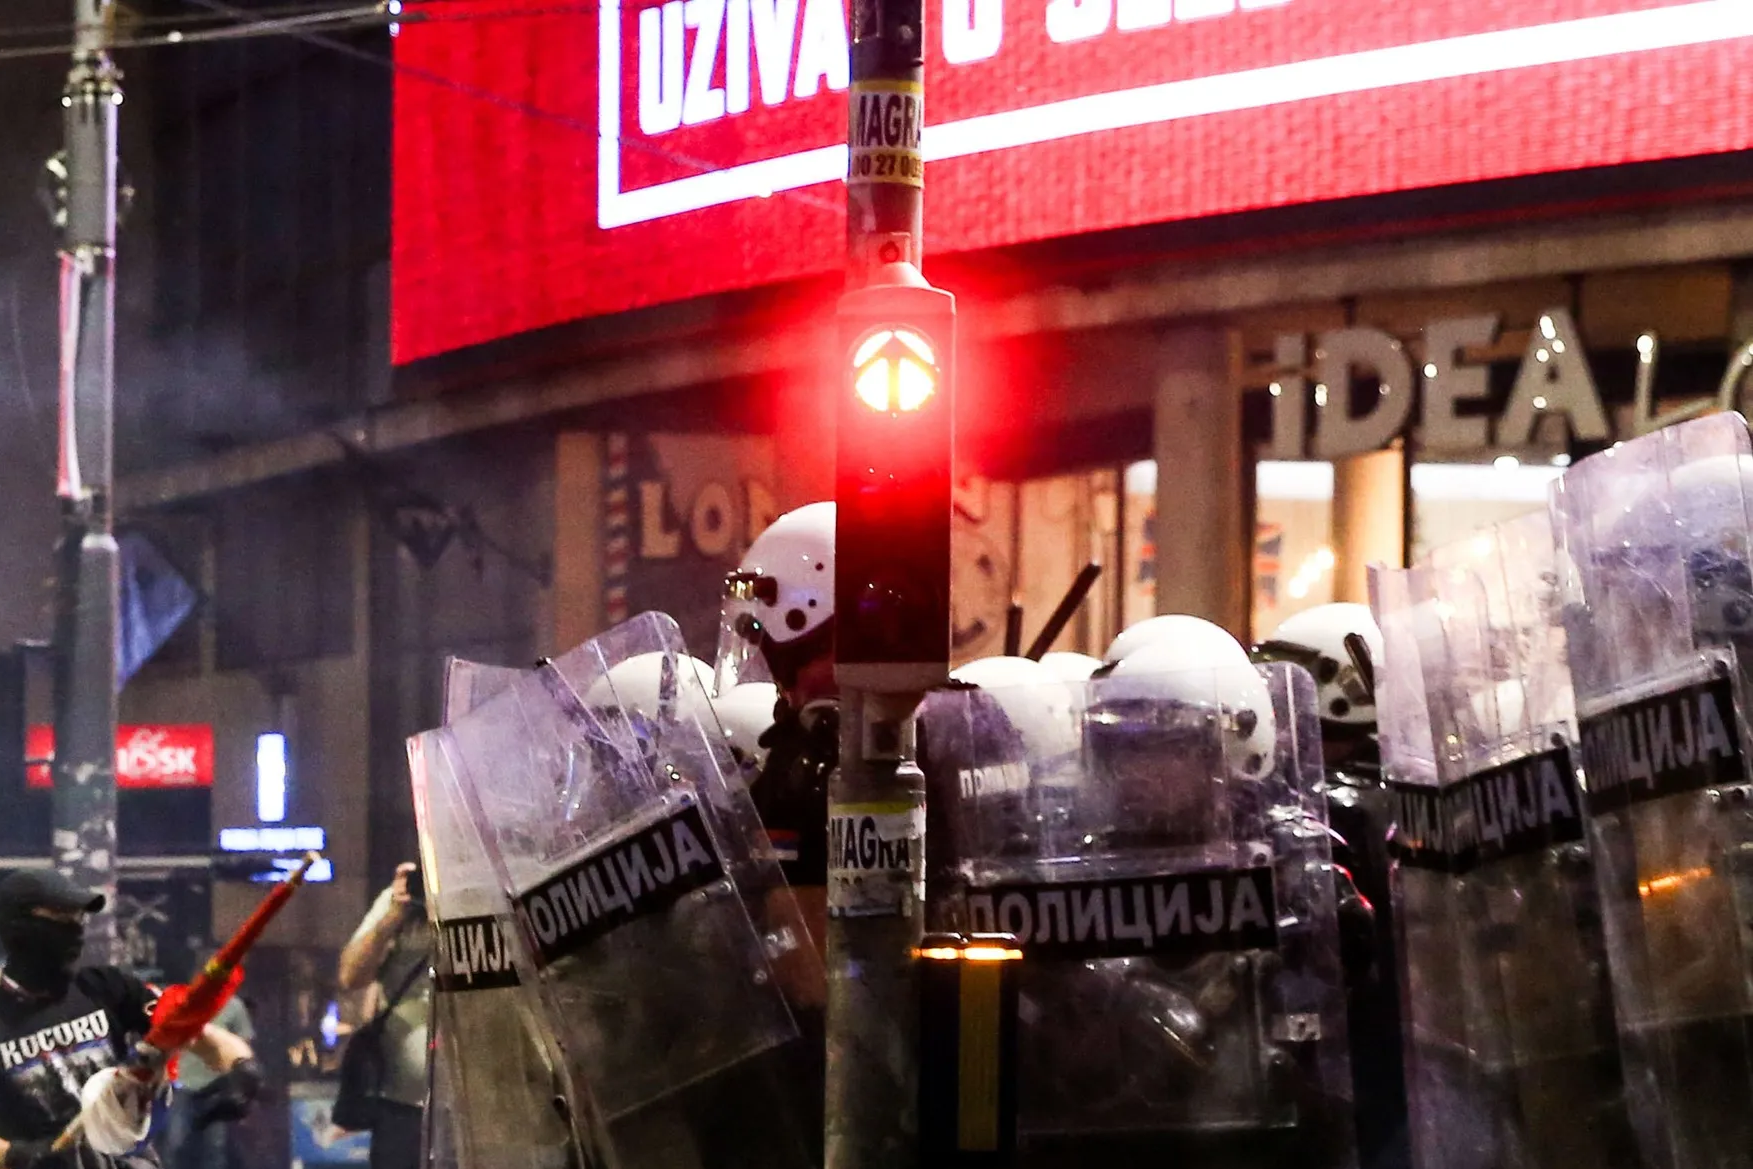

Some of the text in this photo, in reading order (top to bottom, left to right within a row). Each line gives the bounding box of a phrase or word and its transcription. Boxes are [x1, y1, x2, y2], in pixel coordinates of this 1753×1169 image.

[638, 0, 852, 136] UZIVA
[529, 818, 714, 946] ОЛИЦИЈА
[968, 876, 1270, 949] ПОЛИЦИЈА
